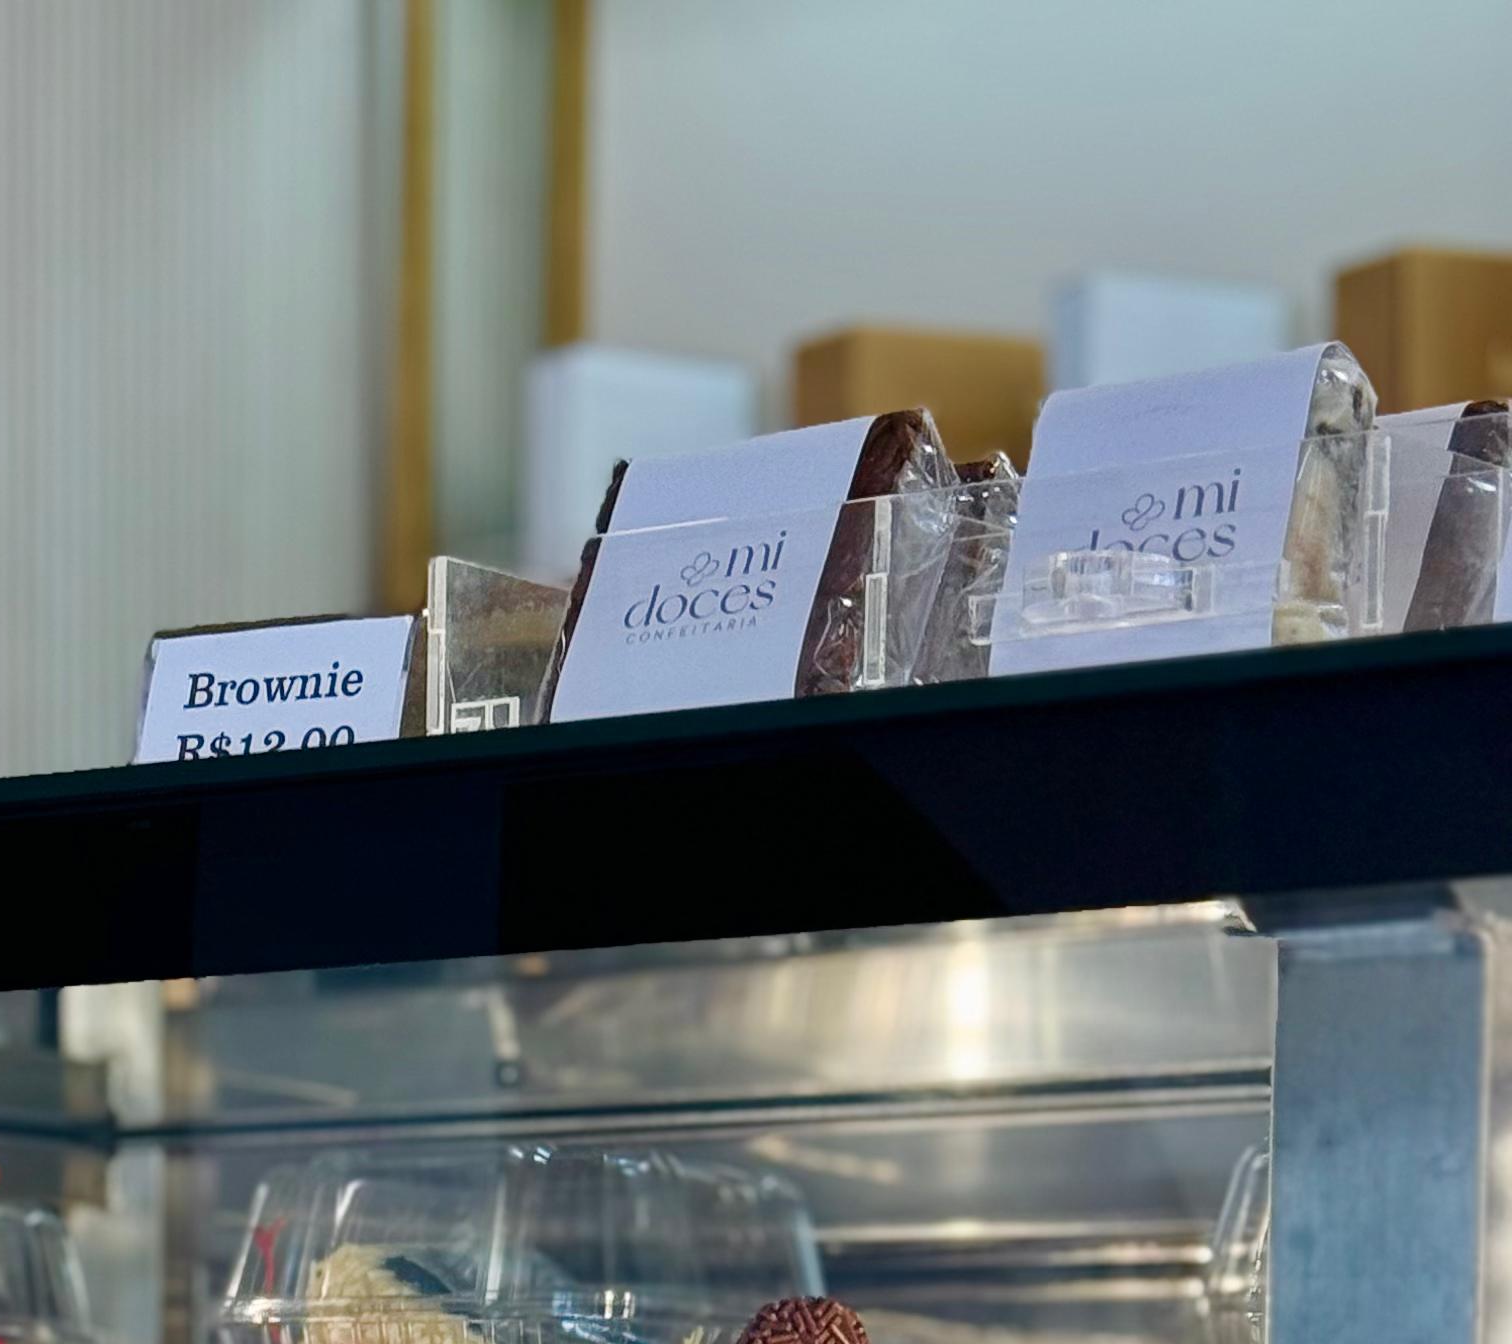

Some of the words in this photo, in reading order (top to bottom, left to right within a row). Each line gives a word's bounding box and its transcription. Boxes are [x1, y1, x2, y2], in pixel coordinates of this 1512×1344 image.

[1173, 468, 1242, 520] mi
[725, 530, 787, 577] mi
[624, 583, 776, 629] doces
[626, 615, 757, 645] CONFEITARIA
[182, 661, 364, 710] Brownie
